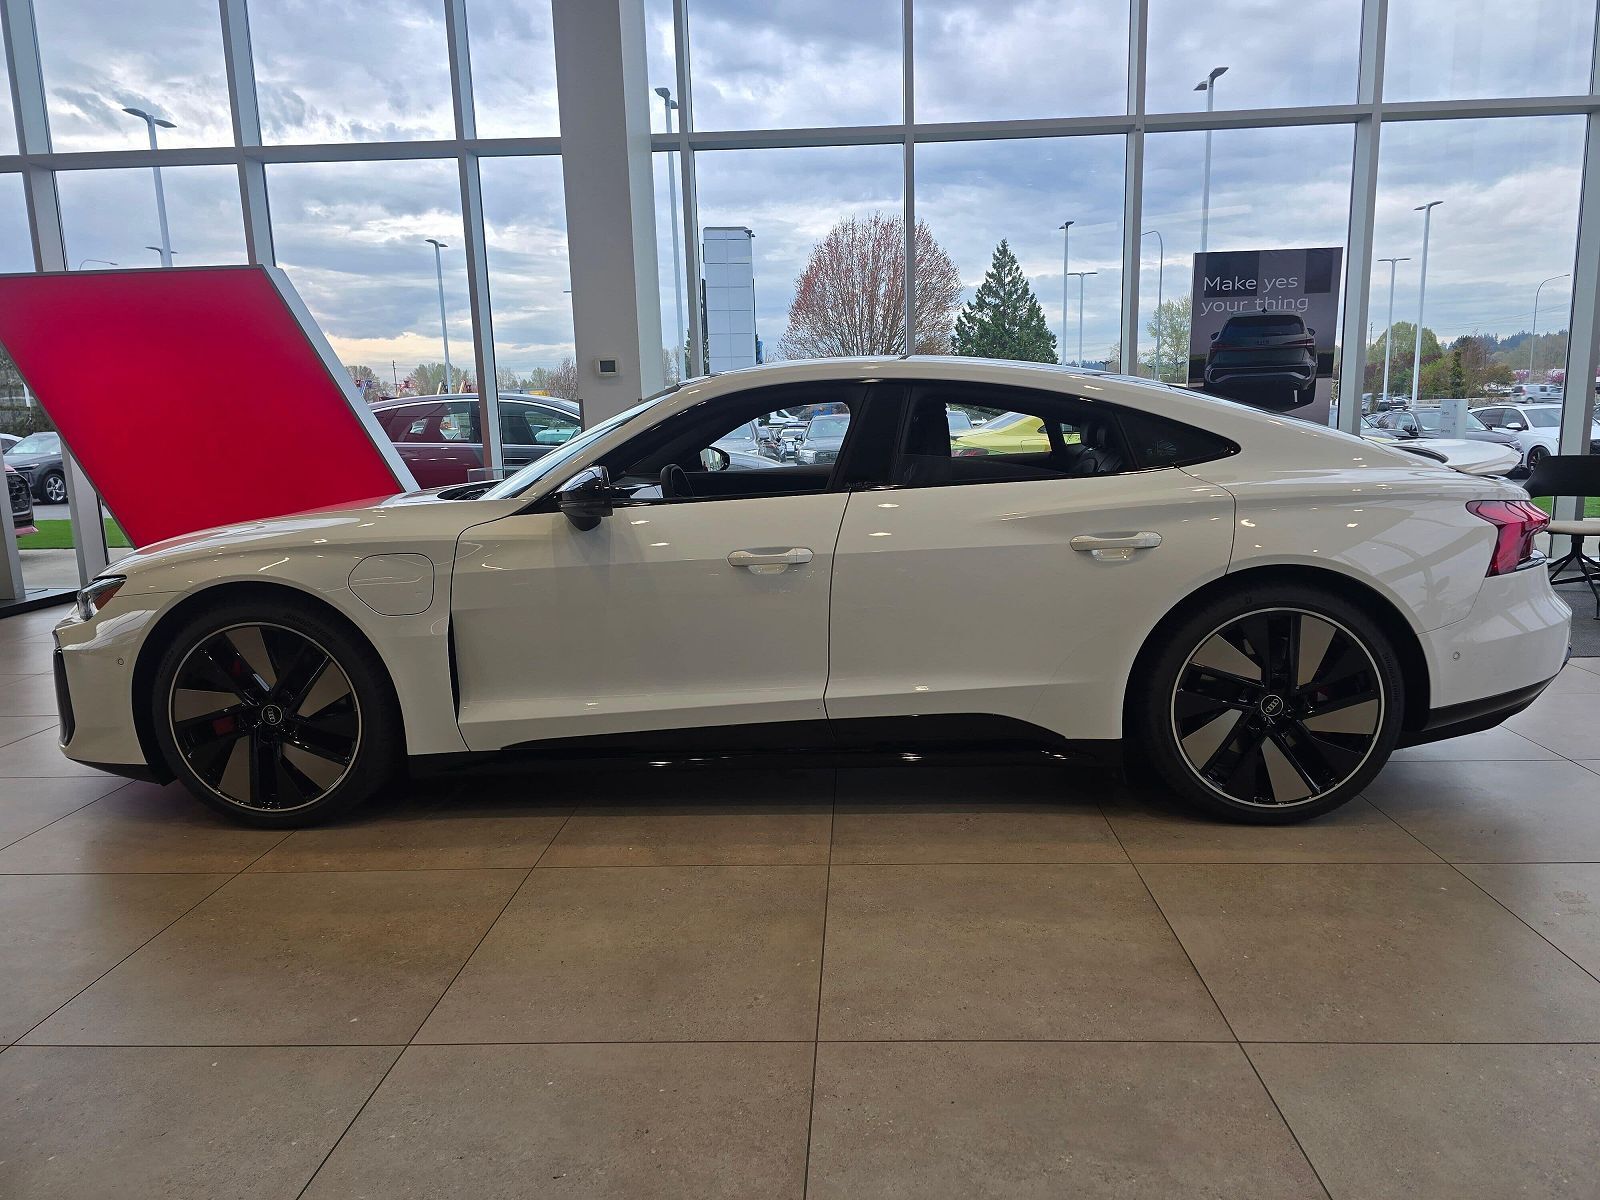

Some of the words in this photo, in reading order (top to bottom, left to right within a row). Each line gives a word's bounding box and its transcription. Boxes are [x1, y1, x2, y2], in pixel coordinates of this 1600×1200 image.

[1203, 275, 1257, 292] Make
[1263, 276, 1299, 293] yes
[1200, 299, 1248, 317] your
[1254, 295, 1309, 313] thing
